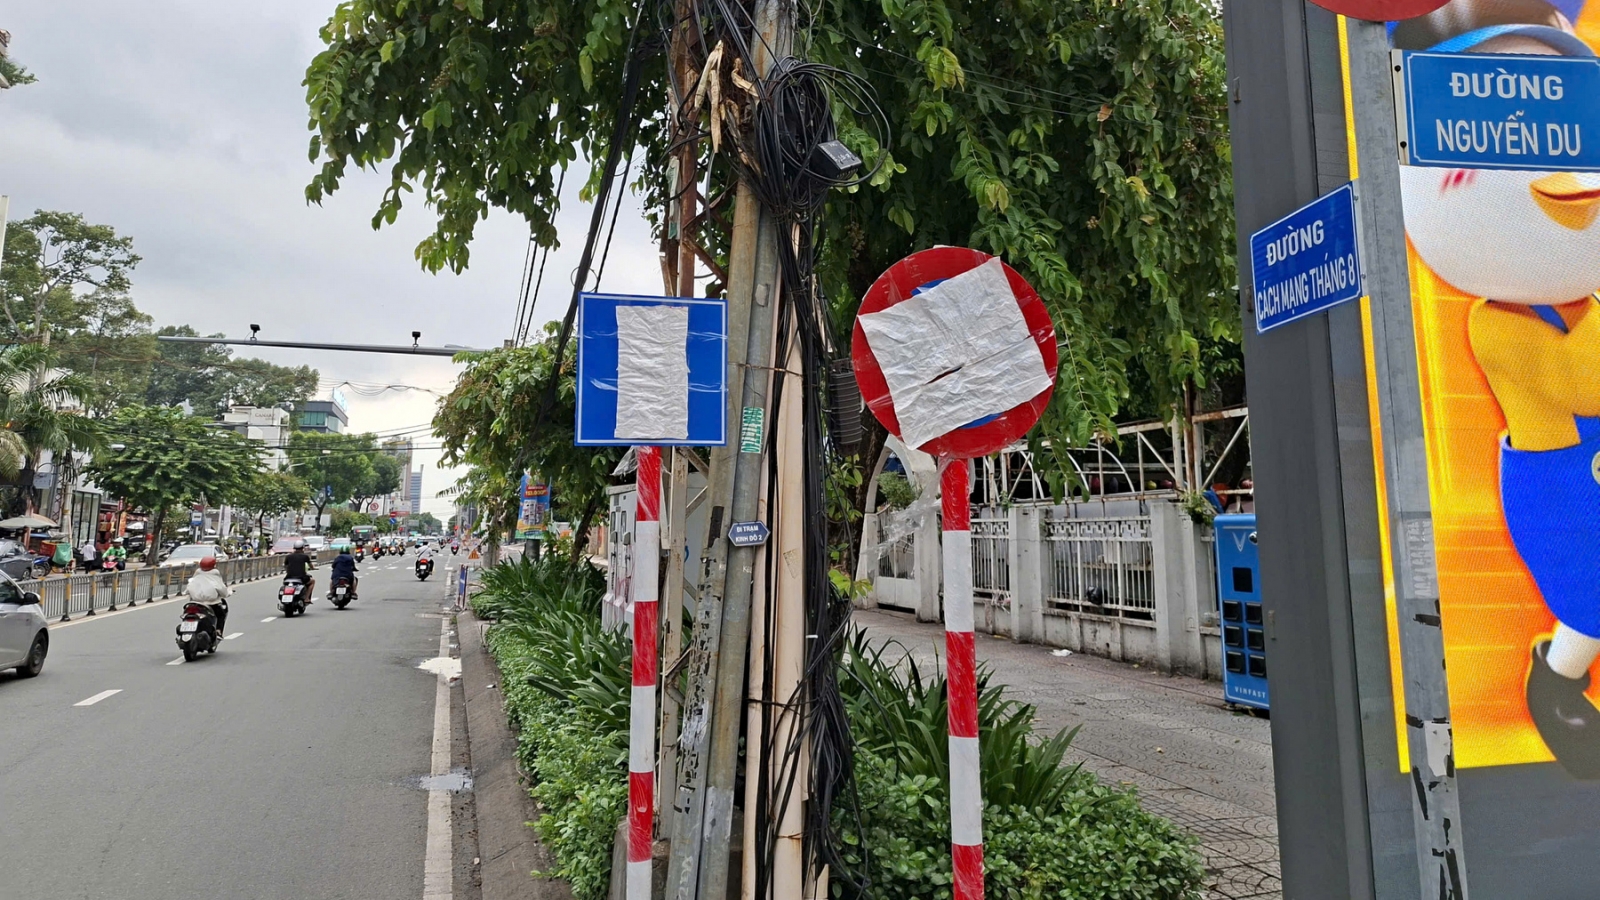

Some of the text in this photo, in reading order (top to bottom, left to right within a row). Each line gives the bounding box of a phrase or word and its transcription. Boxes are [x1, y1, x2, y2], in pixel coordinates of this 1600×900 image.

[1449, 67, 1564, 101] ĐƯỜNG
[1435, 109, 1581, 157] NGUYỄN DU
[1266, 219, 1325, 267] ĐƯỜNG
[1257, 252, 1356, 321] CÁCH MẠNG THÁNG 8
[1234, 686, 1266, 699] VINFAST
